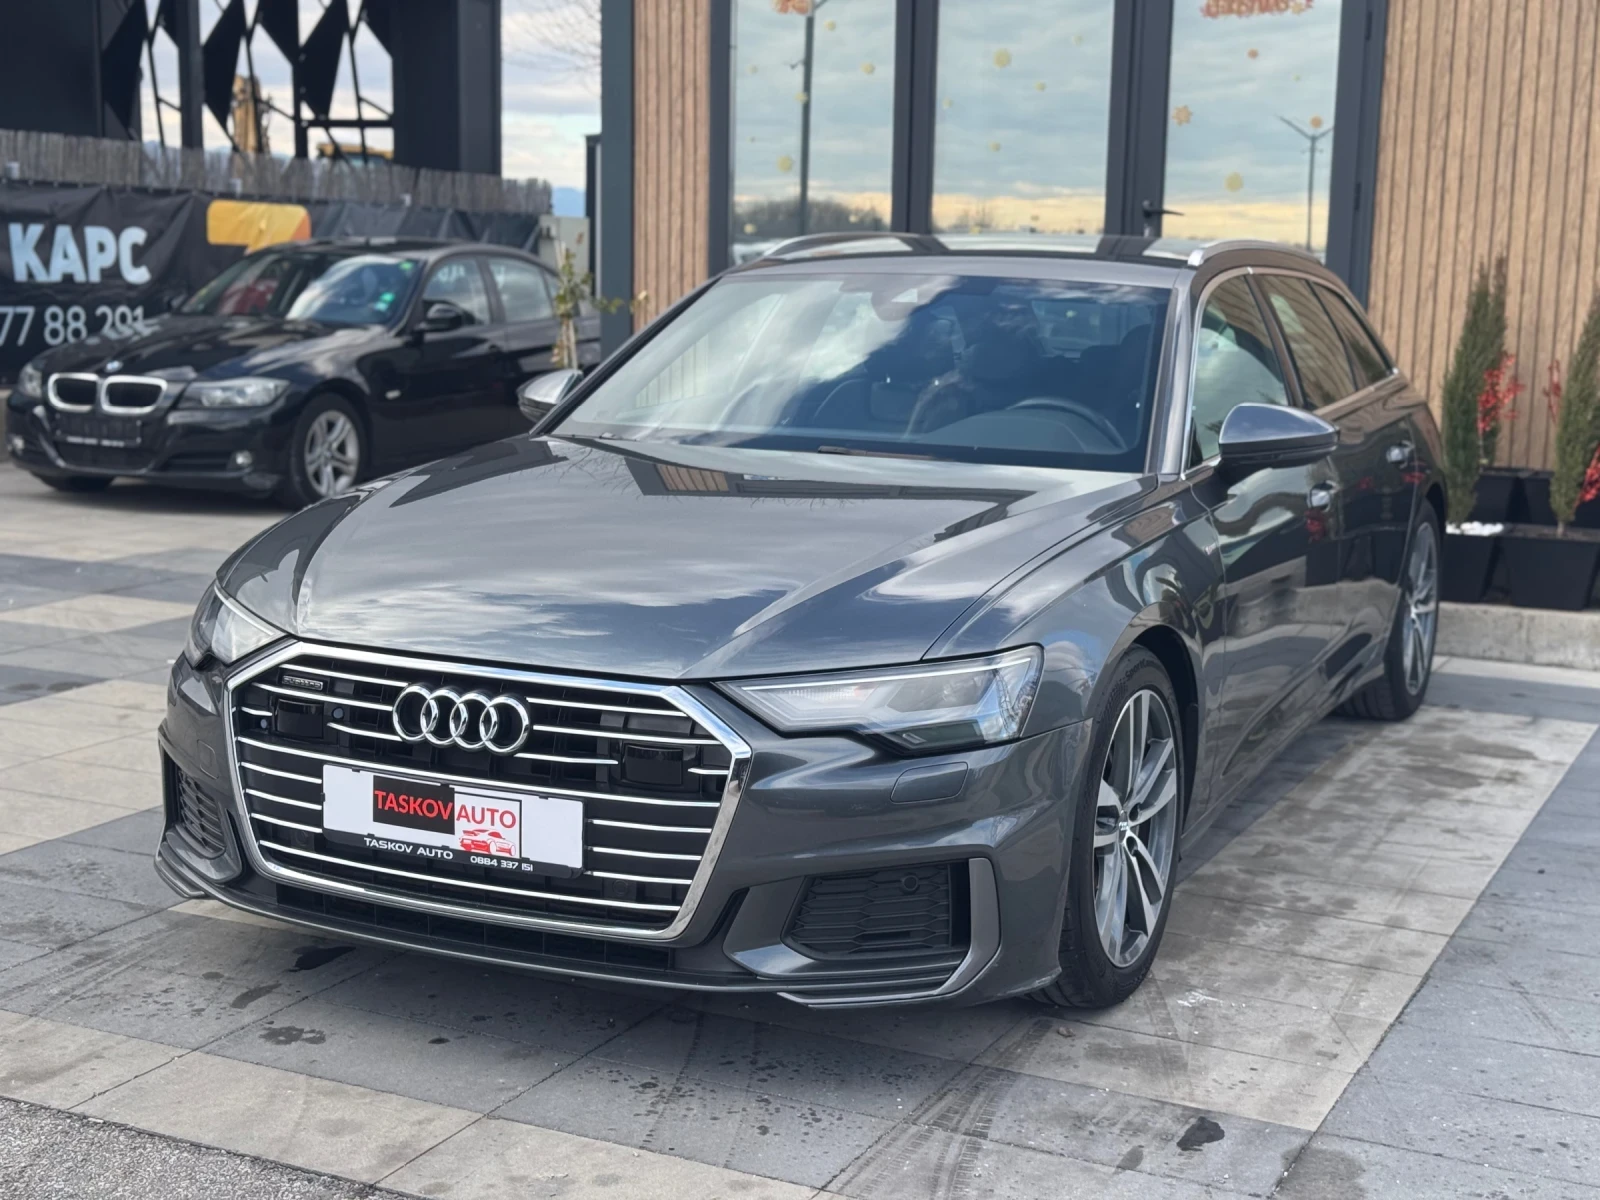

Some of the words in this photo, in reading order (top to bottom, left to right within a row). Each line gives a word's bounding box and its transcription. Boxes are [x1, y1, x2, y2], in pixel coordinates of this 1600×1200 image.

[8, 223, 152, 284] КАРС
[44, 305, 87, 346] 88
[374, 790, 453, 820] TASKOV
[456, 804, 516, 829] AUTO
[363, 837, 413, 853] TASKOV
[417, 847, 453, 860] AUTO
[470, 855, 498, 867] 0884
[500, 860, 519, 870] 337
